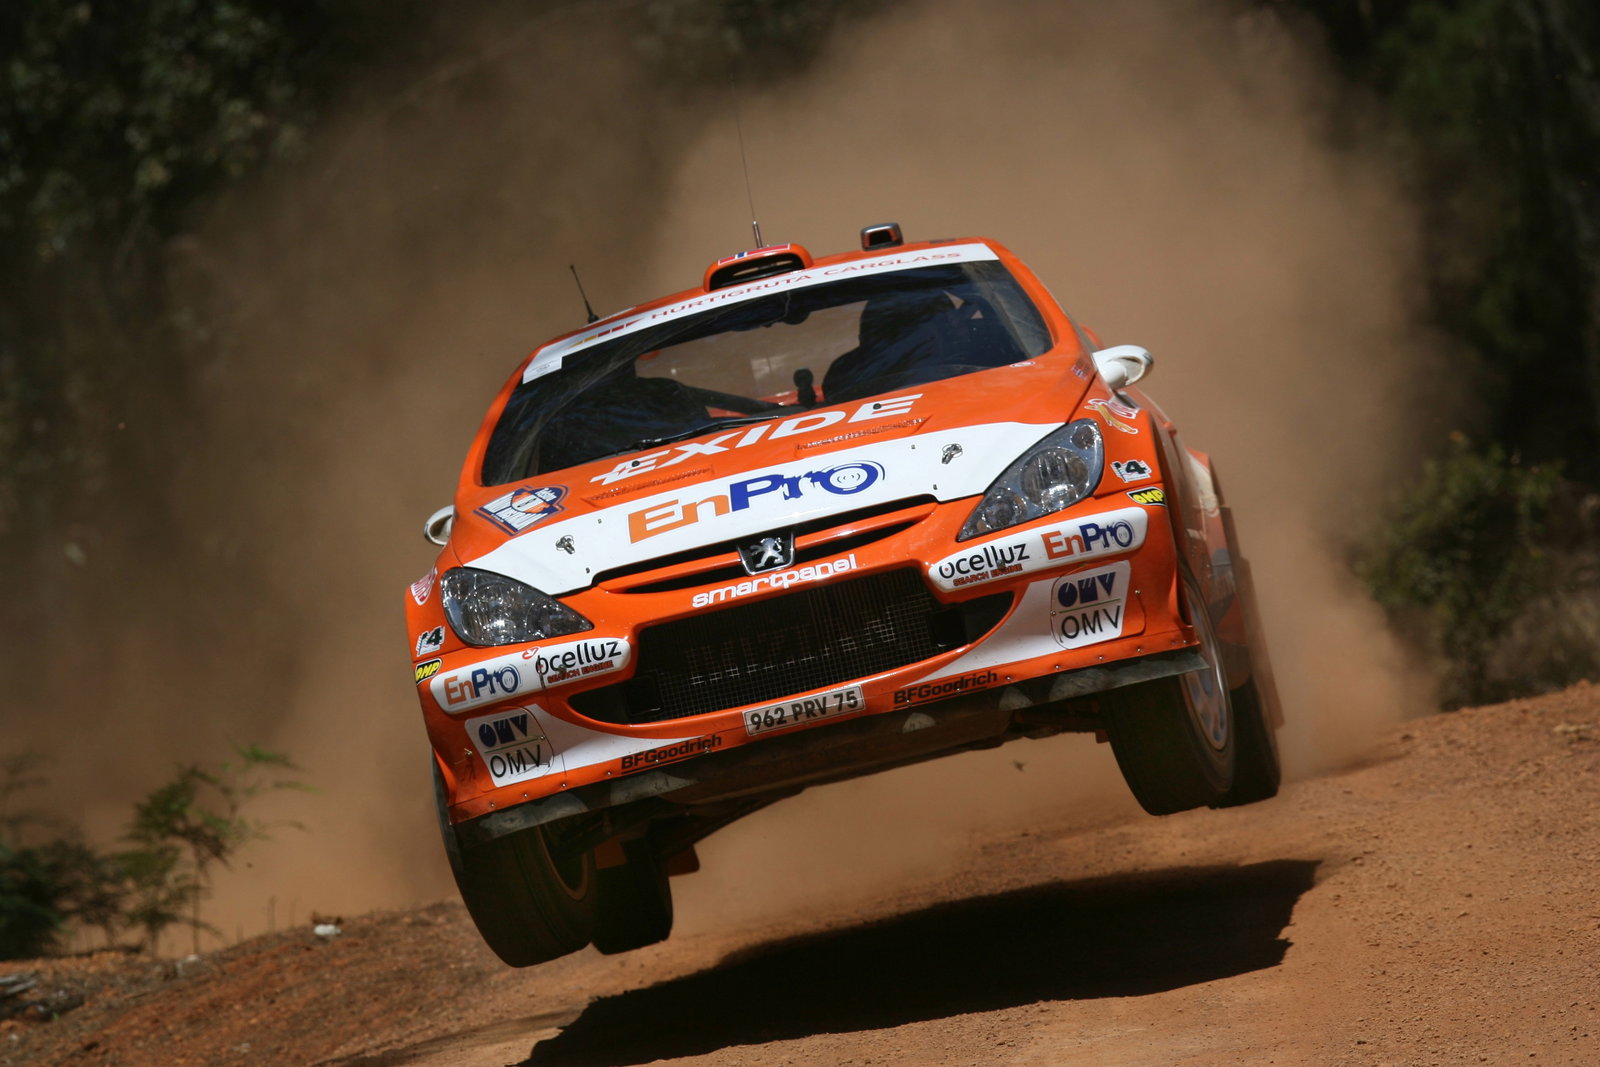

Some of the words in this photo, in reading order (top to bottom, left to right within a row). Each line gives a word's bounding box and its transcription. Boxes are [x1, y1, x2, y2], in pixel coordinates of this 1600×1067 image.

[652, 273, 811, 320] HURTIGRUTA
[824, 252, 960, 277] CARGLASS
[590, 393, 923, 485] EXIDE
[628, 460, 886, 544] EnPro
[1133, 489, 1163, 504] OMP
[1041, 518, 1135, 560] EnPro
[938, 543, 1030, 579] ocelluz
[692, 554, 858, 608] smartpanel
[1058, 571, 1117, 608] OMV
[1061, 605, 1121, 640] OMV
[416, 661, 440, 681] OMP
[535, 641, 622, 676] ocelluz
[444, 664, 522, 705] EnPro
[894, 670, 998, 704] BFGoodrich
[750, 707, 786, 731] 962
[792, 698, 828, 721] PRV
[834, 690, 858, 711] 75
[478, 713, 528, 748] OMV
[490, 744, 542, 778] OMV
[621, 734, 722, 771] BFGoodrich
